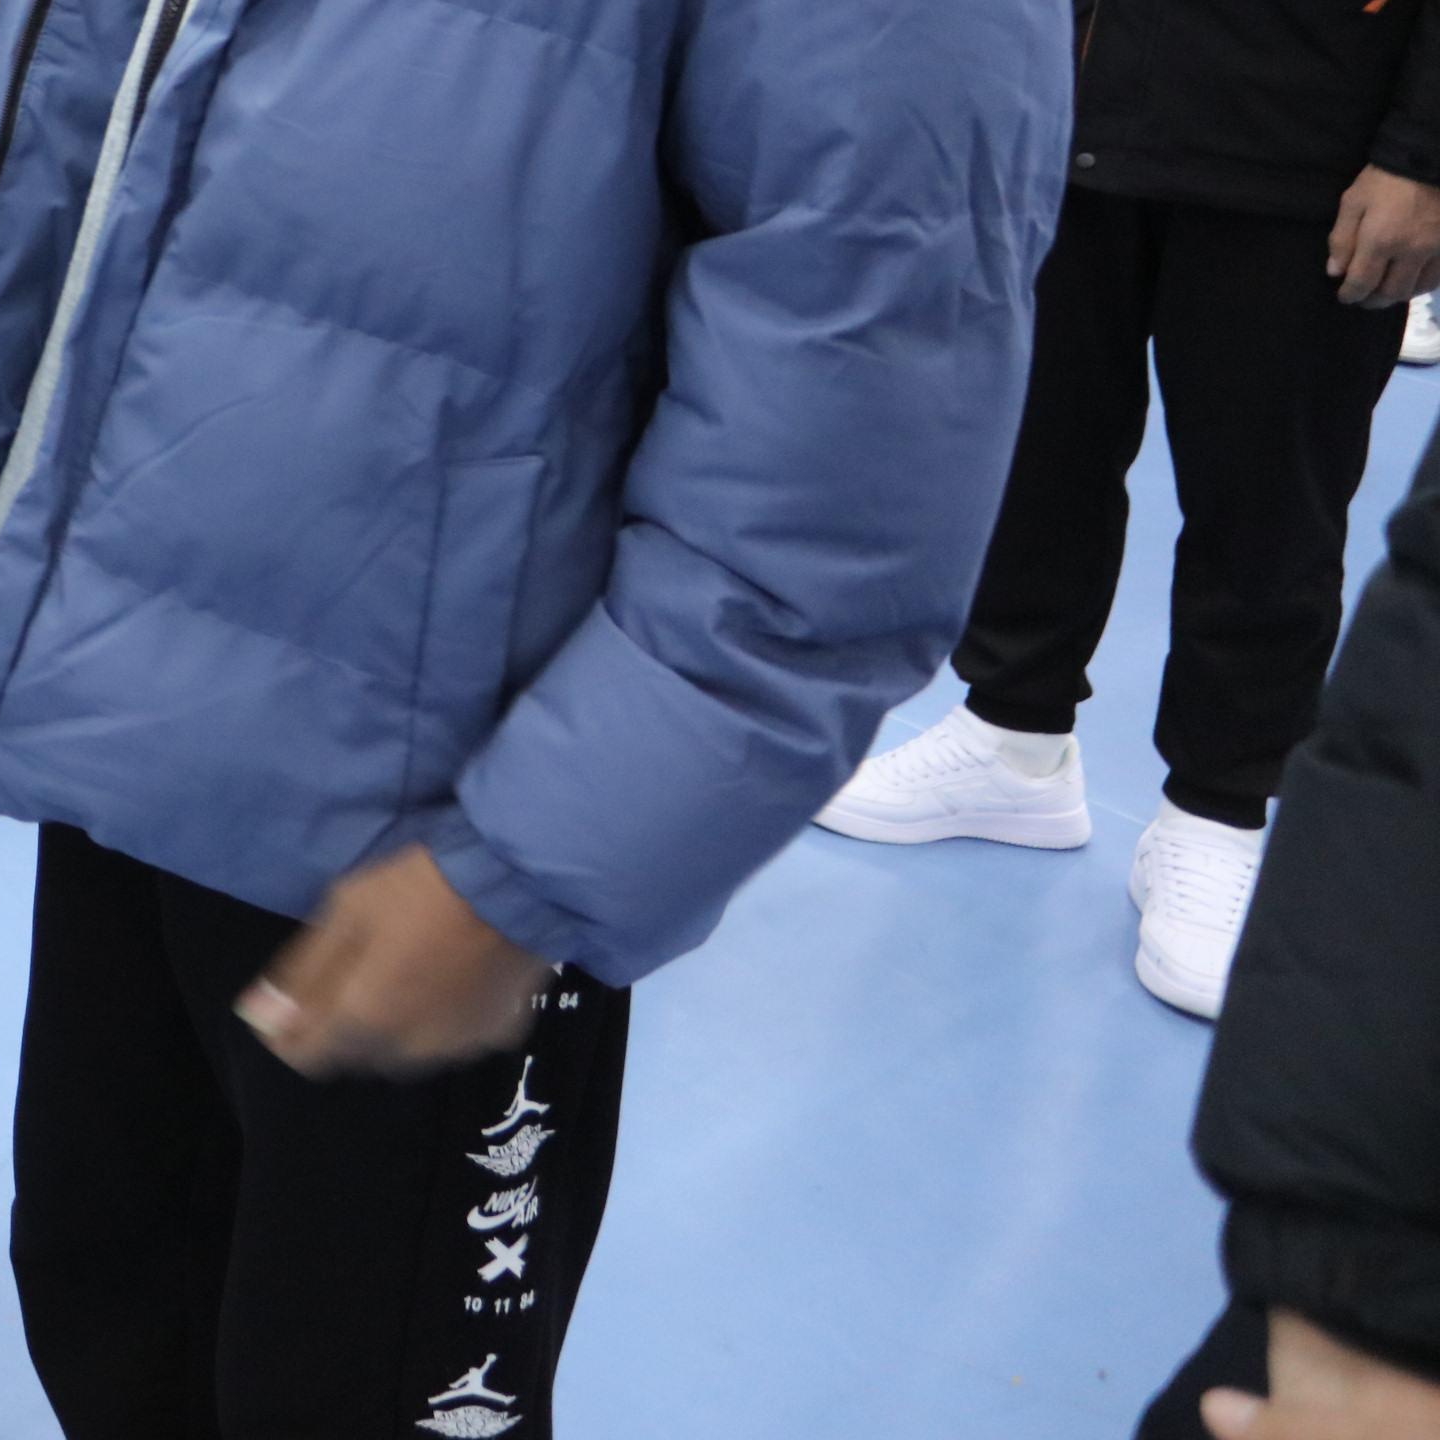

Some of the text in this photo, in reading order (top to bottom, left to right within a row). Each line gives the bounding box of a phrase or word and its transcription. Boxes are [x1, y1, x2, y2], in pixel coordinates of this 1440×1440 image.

[558, 991, 579, 1010] 84
[483, 1181, 530, 1213] NIKE
[463, 1295, 483, 1313] 10
[494, 1297, 511, 1315] 11
